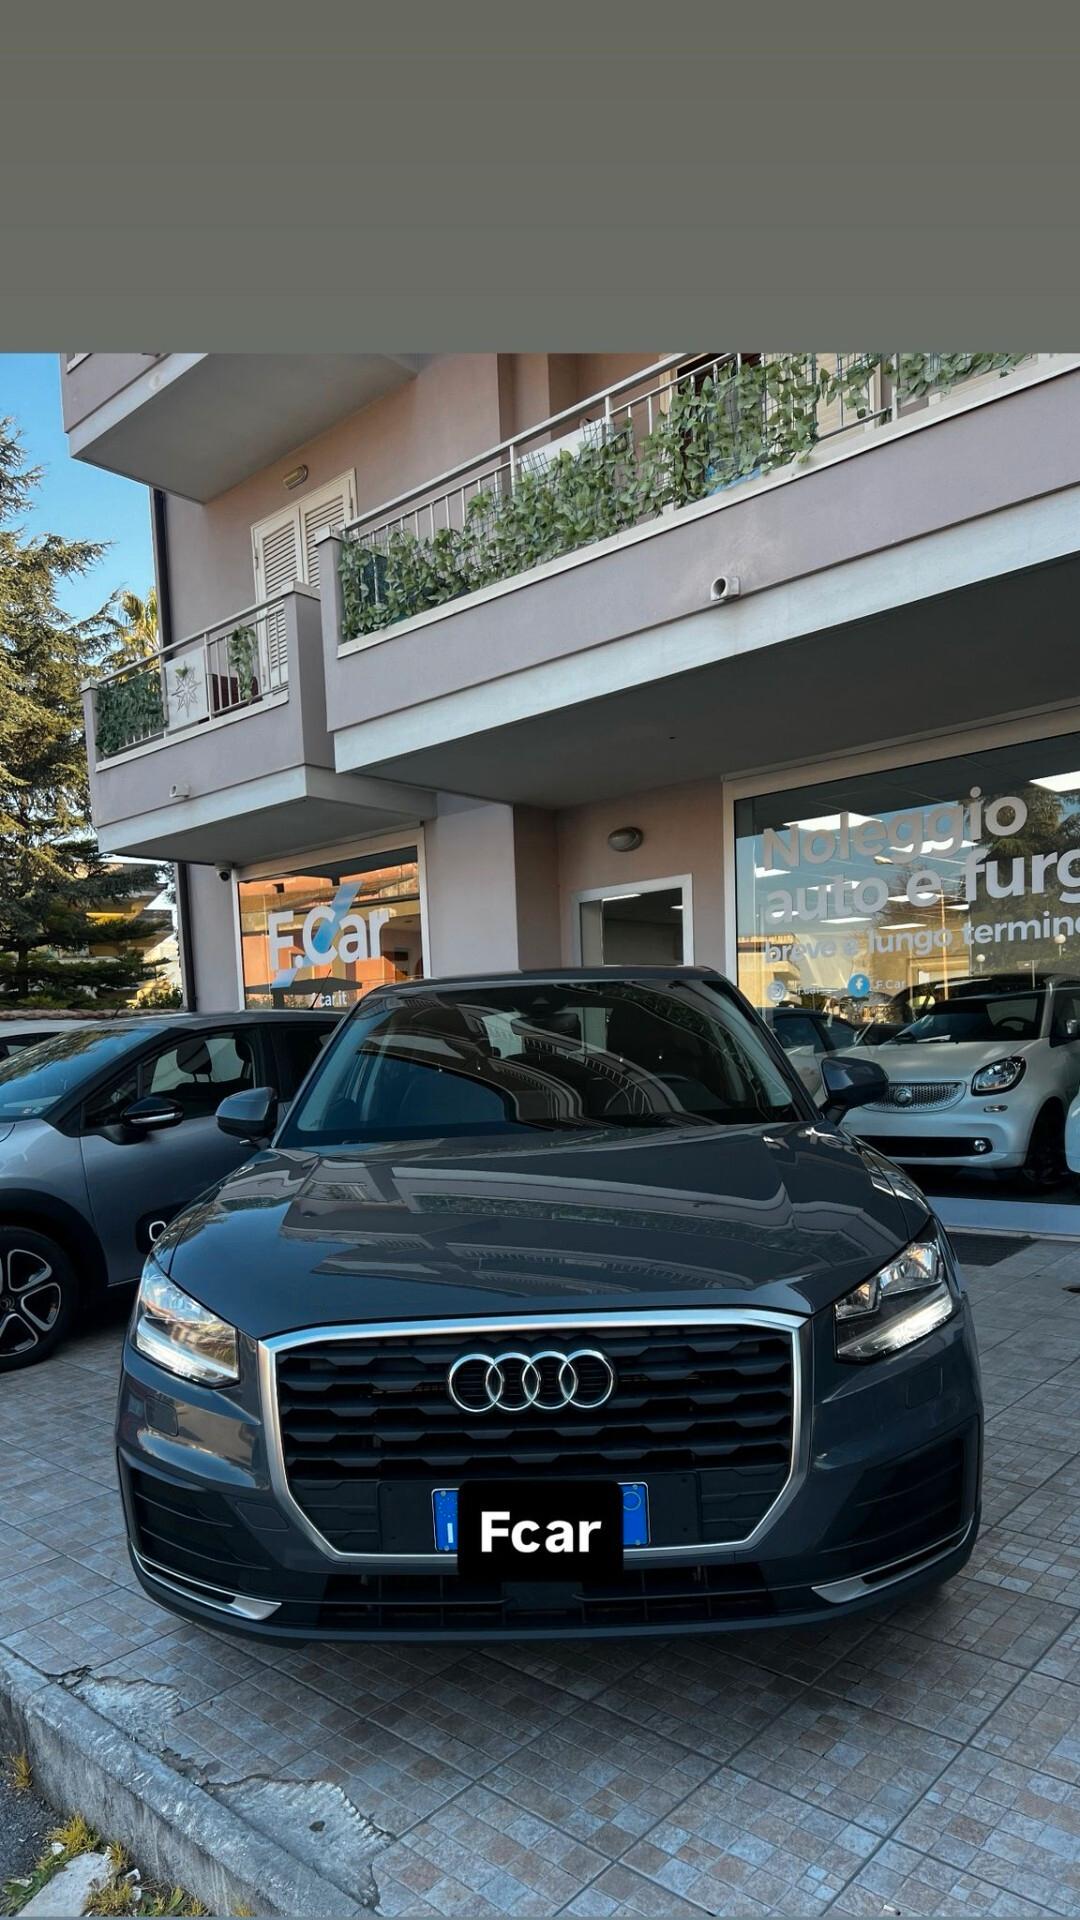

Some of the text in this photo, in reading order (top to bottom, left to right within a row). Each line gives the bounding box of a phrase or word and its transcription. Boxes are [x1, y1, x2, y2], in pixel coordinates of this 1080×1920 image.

[763, 786, 1028, 870] Noleggio
[765, 873, 889, 925] auto
[906, 869, 942, 908] e
[268, 906, 390, 971] F.Car
[765, 938, 837, 963] breve
[867, 925, 953, 956] lungo
